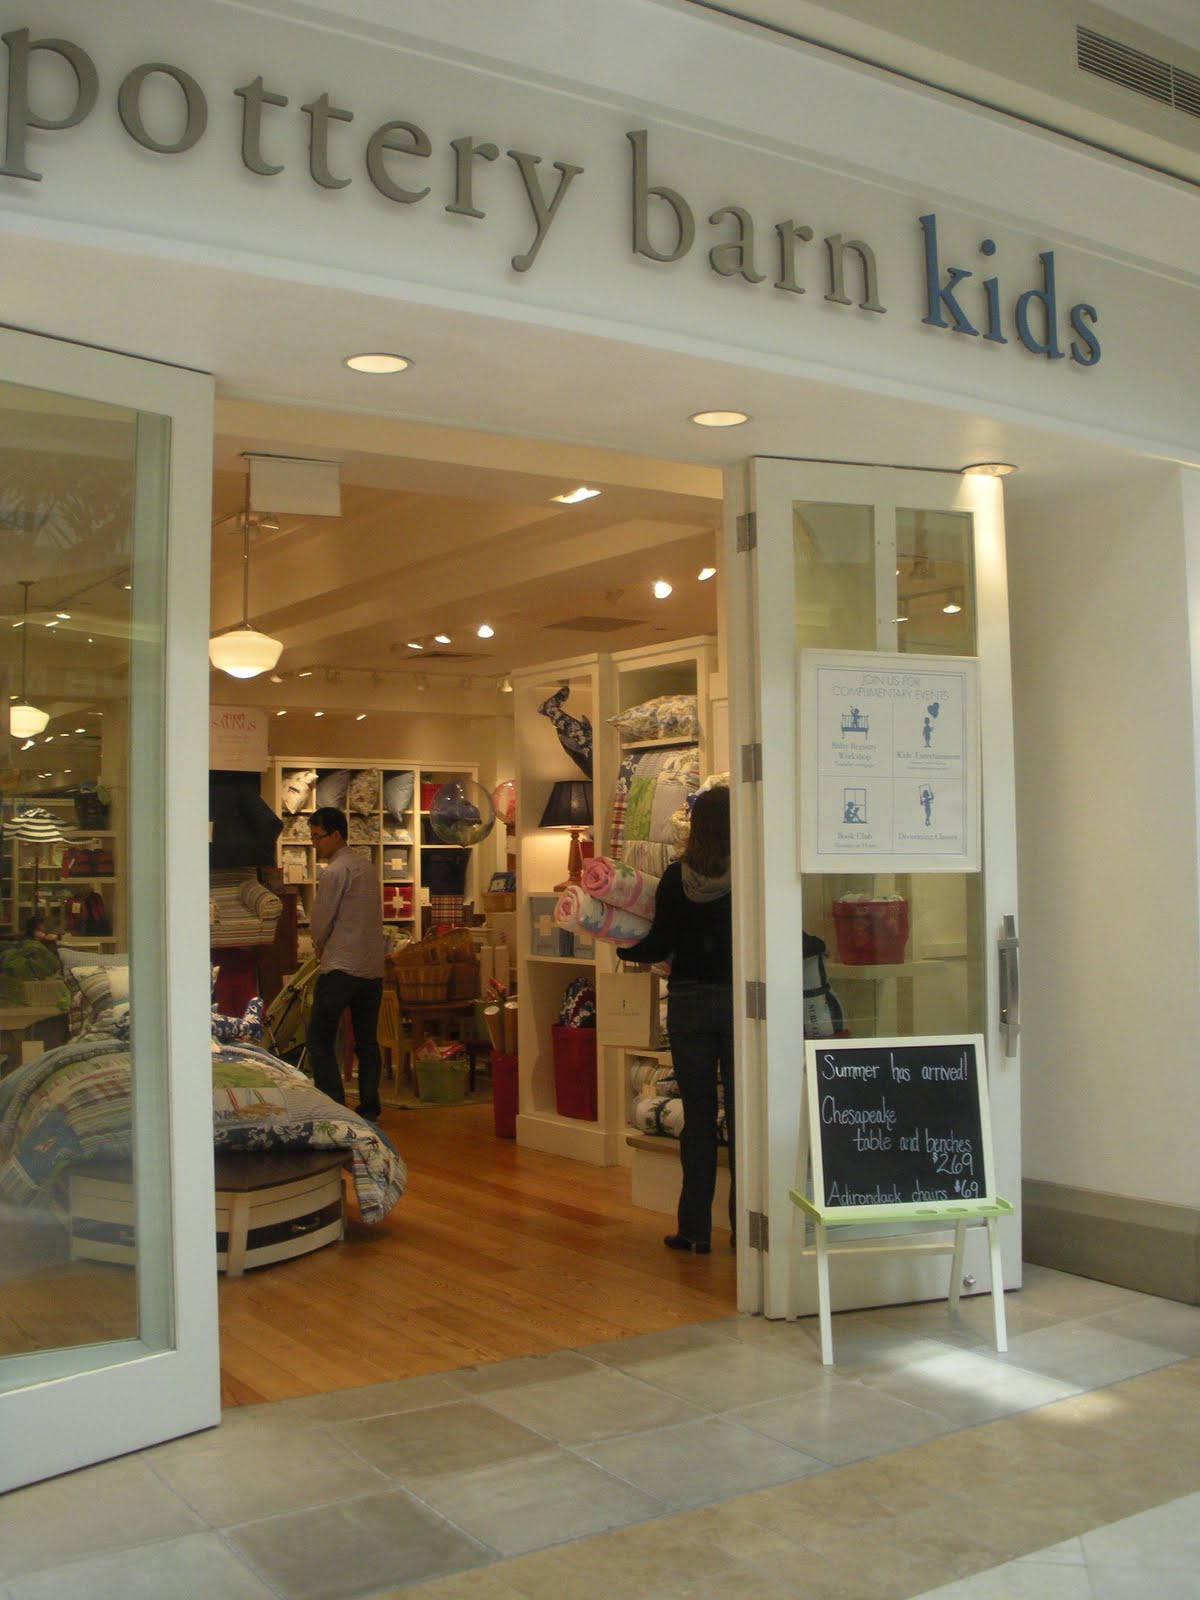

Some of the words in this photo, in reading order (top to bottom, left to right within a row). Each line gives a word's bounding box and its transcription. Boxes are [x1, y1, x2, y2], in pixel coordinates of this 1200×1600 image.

[0, 27, 584, 272] pottery
[626, 129, 887, 314] barn
[919, 213, 1101, 366] kids
[832, 685, 913, 698] COMPLIMENTARY
[916, 688, 950, 700] EVENTS
[861, 674, 884, 686] JOIN
[887, 676, 900, 686] US
[902, 677, 920, 688] FOR
[856, 832, 873, 840] Club
[822, 1054, 880, 1081] Summer
[890, 1052, 910, 1083] has
[922, 1051, 968, 1081] arrived!
[822, 1095, 897, 1132] Chesapeake
[853, 1128, 892, 1152] table
[900, 1127, 919, 1151] and
[925, 1127, 972, 1153] benches
[932, 1152, 973, 1175] $269
[827, 1180, 901, 1206] Adirondack
[912, 1179, 948, 1203] chairs
[954, 1179, 979, 1198] $69
